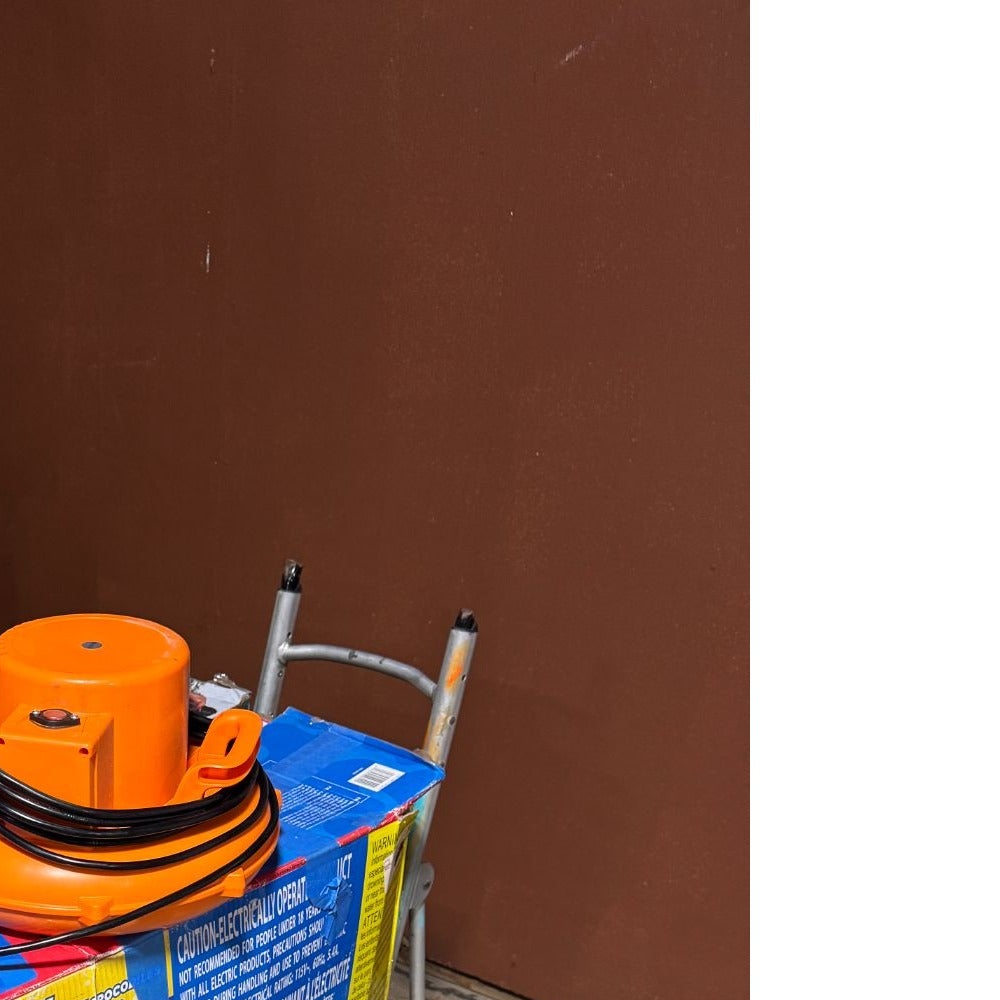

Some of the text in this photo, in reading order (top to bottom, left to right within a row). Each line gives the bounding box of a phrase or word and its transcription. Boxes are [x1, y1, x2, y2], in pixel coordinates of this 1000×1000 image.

[277, 876, 308, 916] OPERAT
[179, 967, 192, 987] NOT
[194, 944, 240, 979] RECOMMENDED
[242, 937, 255, 956] FOR
[256, 926, 277, 949] PEOPLE
[278, 914, 296, 937] UNDER
[198, 980, 209, 998] ALL
[211, 965, 238, 991] ELECTRIC
[273, 927, 307, 959] PRECAUTIONS
[238, 969, 268, 997] HANDLING
[269, 962, 280, 980] AND
[281, 954, 292, 972] USE
[294, 949, 300, 965] TO
[301, 936, 323, 960] PREVENT
